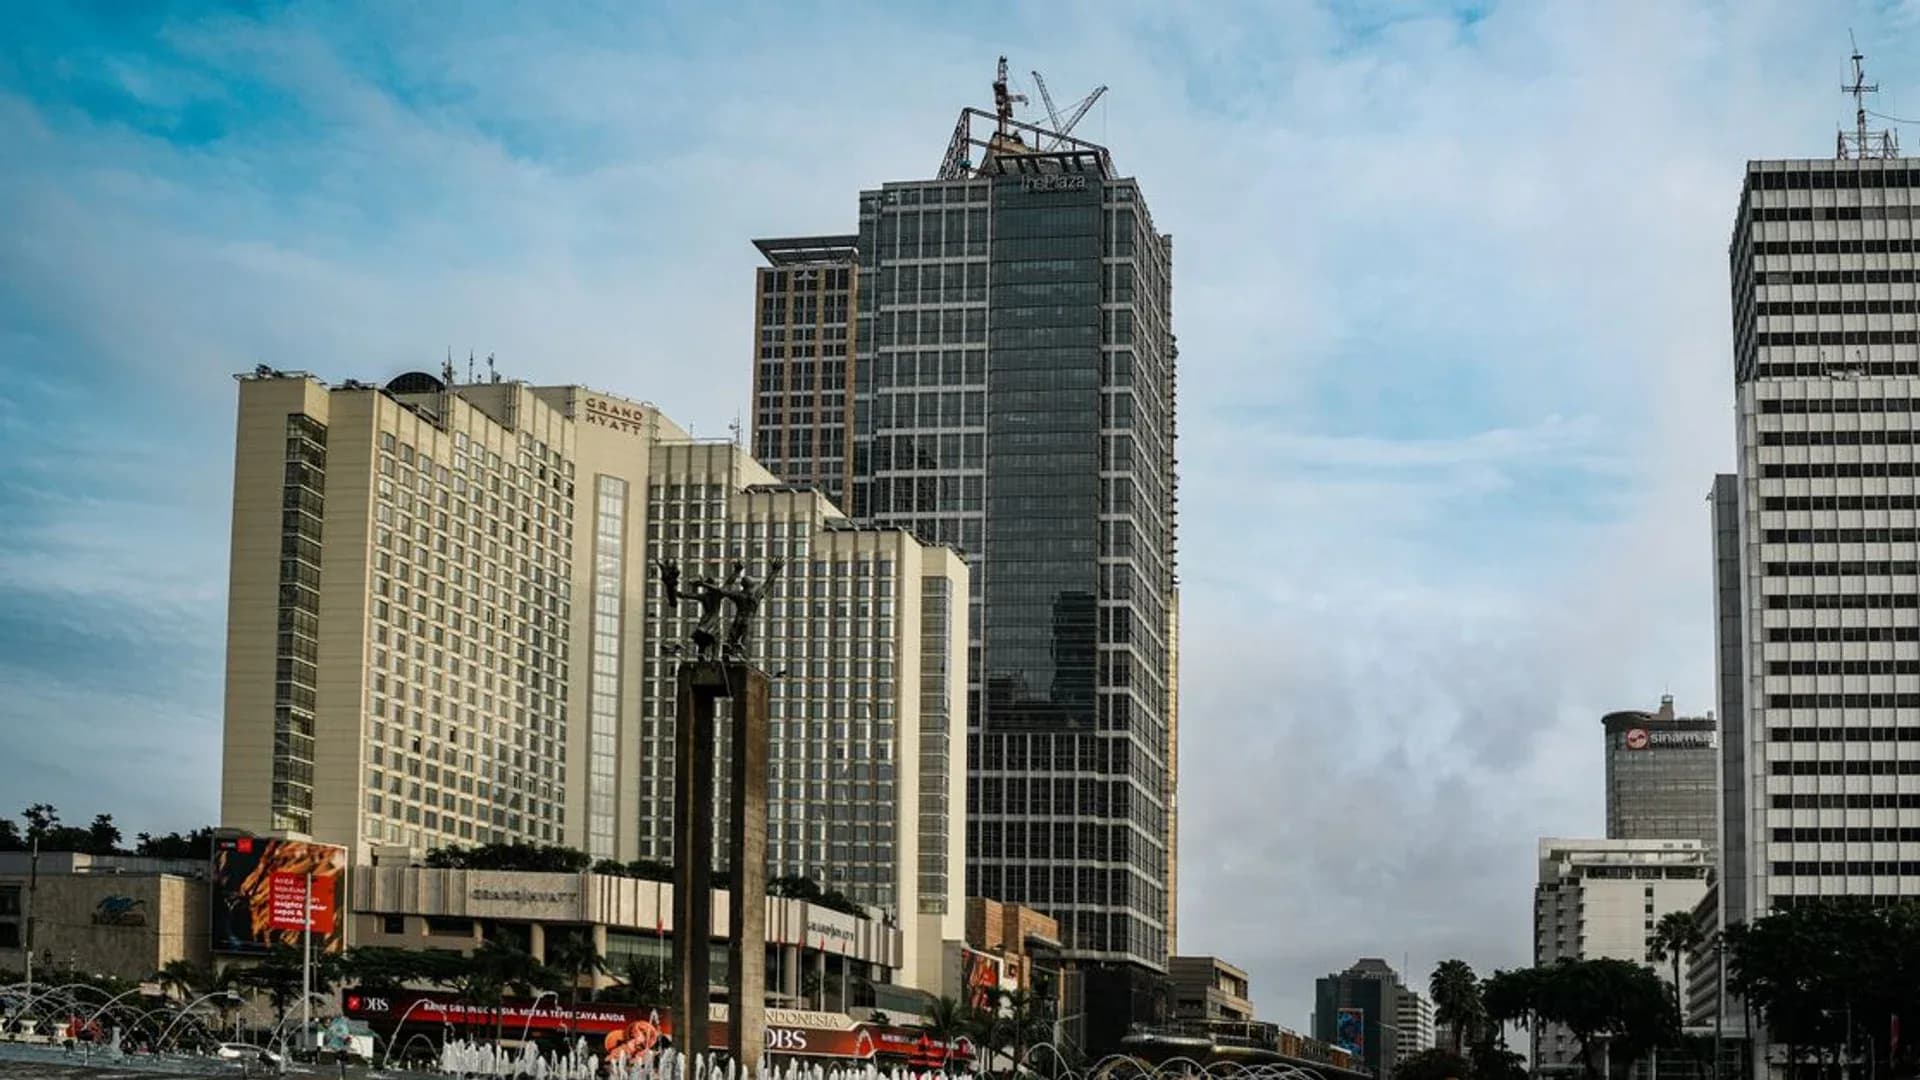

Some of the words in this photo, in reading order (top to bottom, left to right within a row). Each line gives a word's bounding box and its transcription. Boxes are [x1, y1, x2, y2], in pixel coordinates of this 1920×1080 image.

[585, 397, 643, 421] GRAND
[586, 413, 641, 435] HYATT
[362, 997, 390, 1011] DBS
[599, 1012, 625, 1022] ANDA
